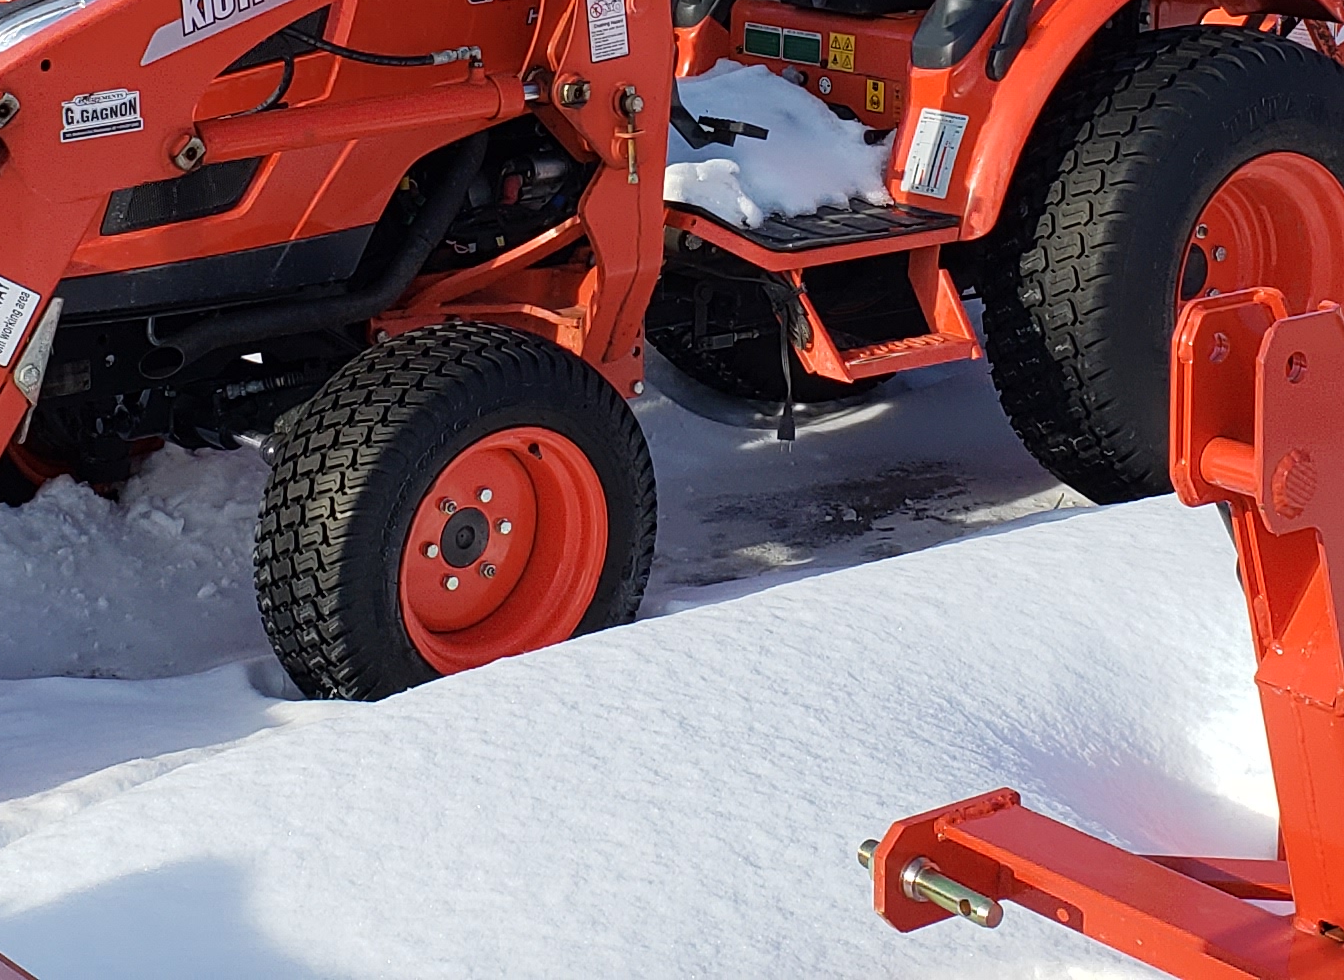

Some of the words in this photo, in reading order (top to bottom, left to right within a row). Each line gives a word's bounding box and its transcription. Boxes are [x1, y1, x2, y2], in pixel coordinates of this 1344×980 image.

[64, 97, 138, 126] G.GAGNON
[0, 309, 24, 340] working
[15, 291, 31, 310] area
